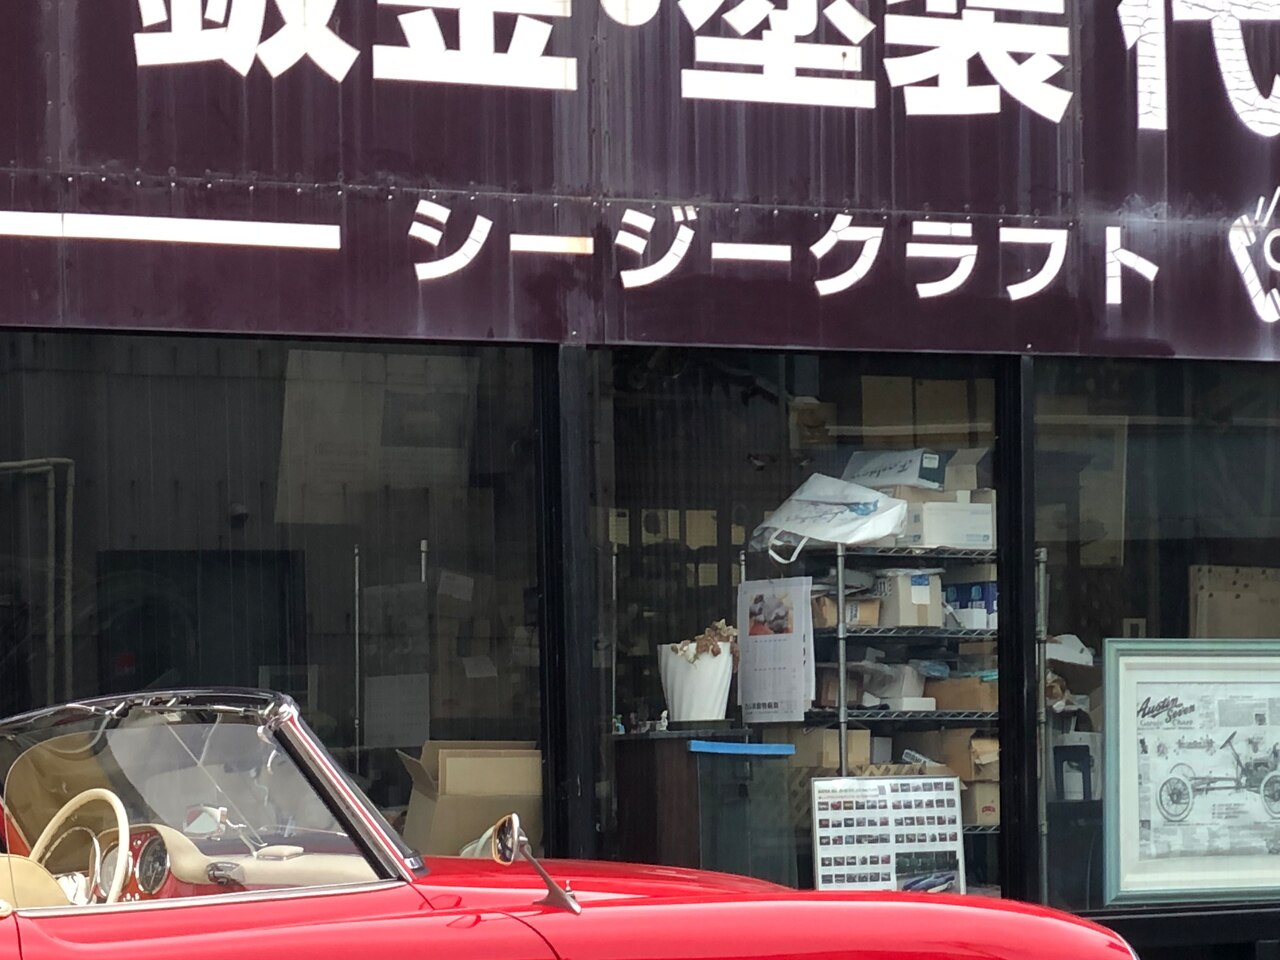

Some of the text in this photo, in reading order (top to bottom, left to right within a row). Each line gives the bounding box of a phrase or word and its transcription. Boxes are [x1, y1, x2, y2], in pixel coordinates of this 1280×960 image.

[408, 199, 1159, 304] シージークラフト
